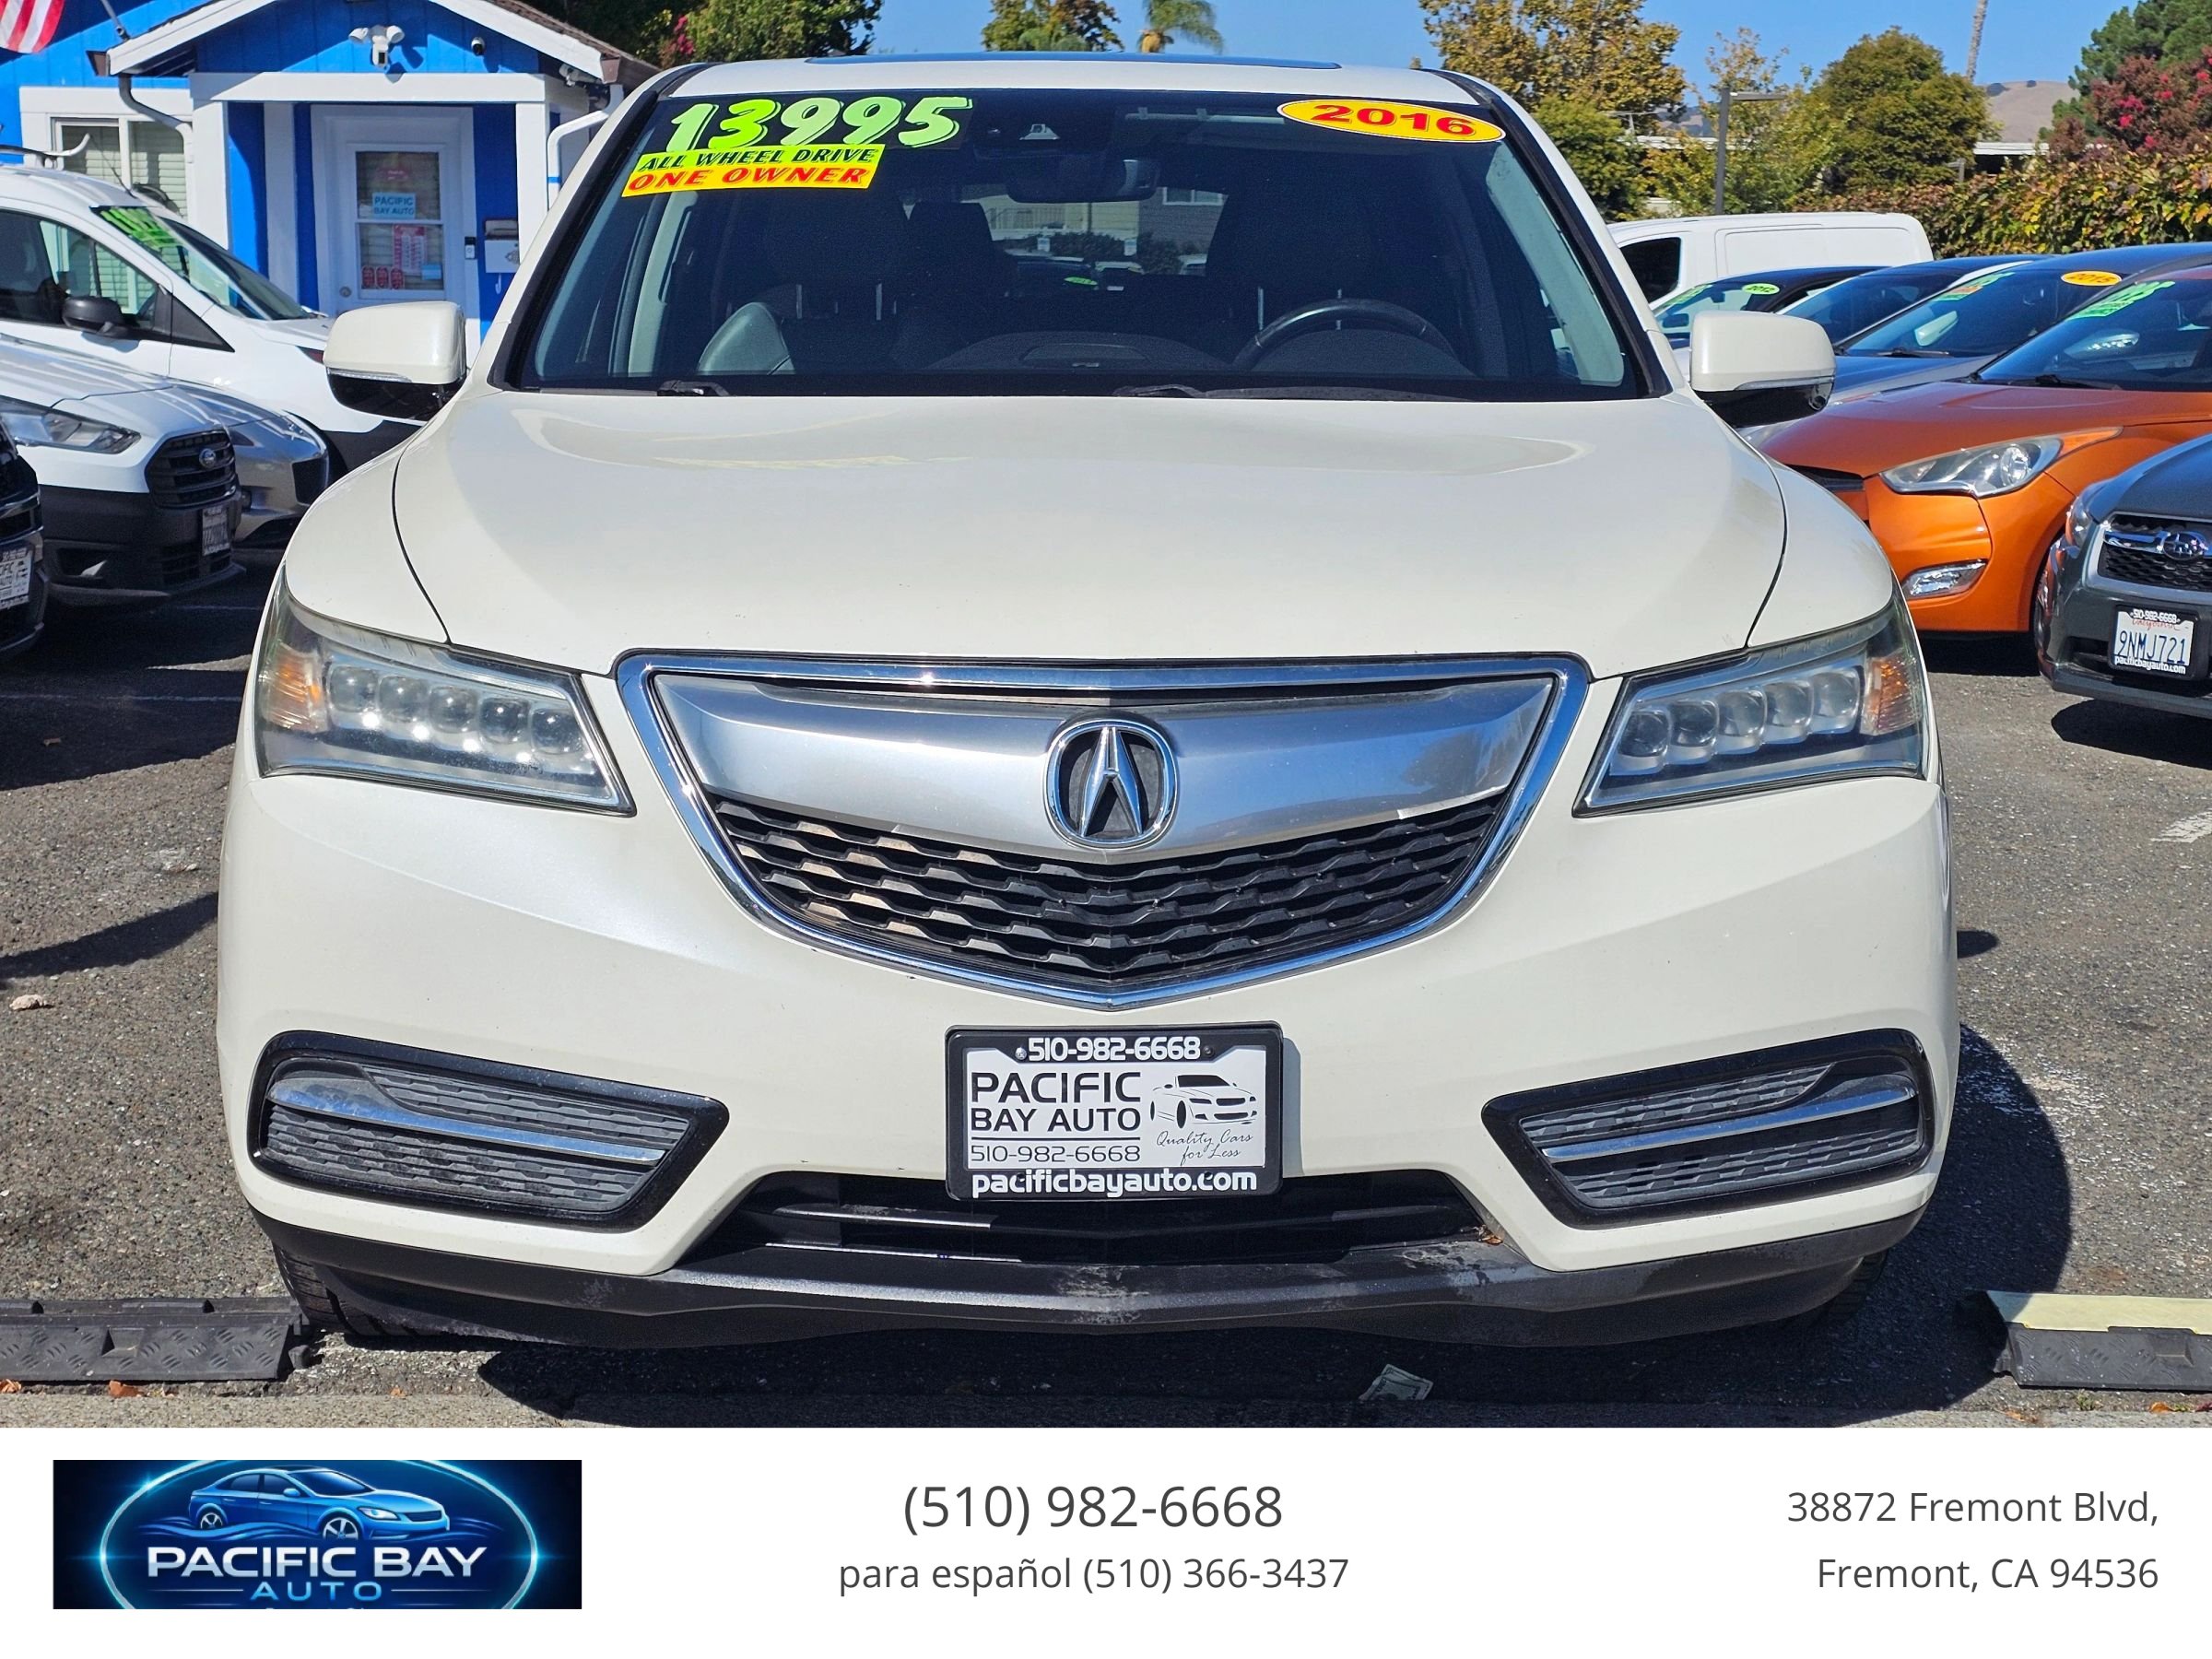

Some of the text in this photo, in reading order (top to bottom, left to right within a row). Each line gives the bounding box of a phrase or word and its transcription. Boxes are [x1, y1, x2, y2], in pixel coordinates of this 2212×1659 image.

[666, 96, 973, 153] 13995
[1311, 104, 1477, 136] 2016
[639, 148, 877, 171] ALL WHEEL DRIVE
[629, 167, 869, 191] ONE OWNER
[374, 195, 413, 206] PACIFIC
[374, 206, 415, 216] BAY AUTO
[2118, 630, 2186, 665] 9NMJ721
[2114, 654, 2186, 675] pacificbayauto.com
[1028, 1036, 1201, 1062] 510-982-6668
[971, 1071, 1141, 1104] PACIFIC
[971, 1108, 1141, 1132] BAY AUTO
[1157, 1129, 1253, 1152] Quality Cars
[971, 1145, 1141, 1162] 510-982-6668
[1180, 1143, 1241, 1167] for Less
[972, 1168, 1257, 1198] pacificbayauto.com
